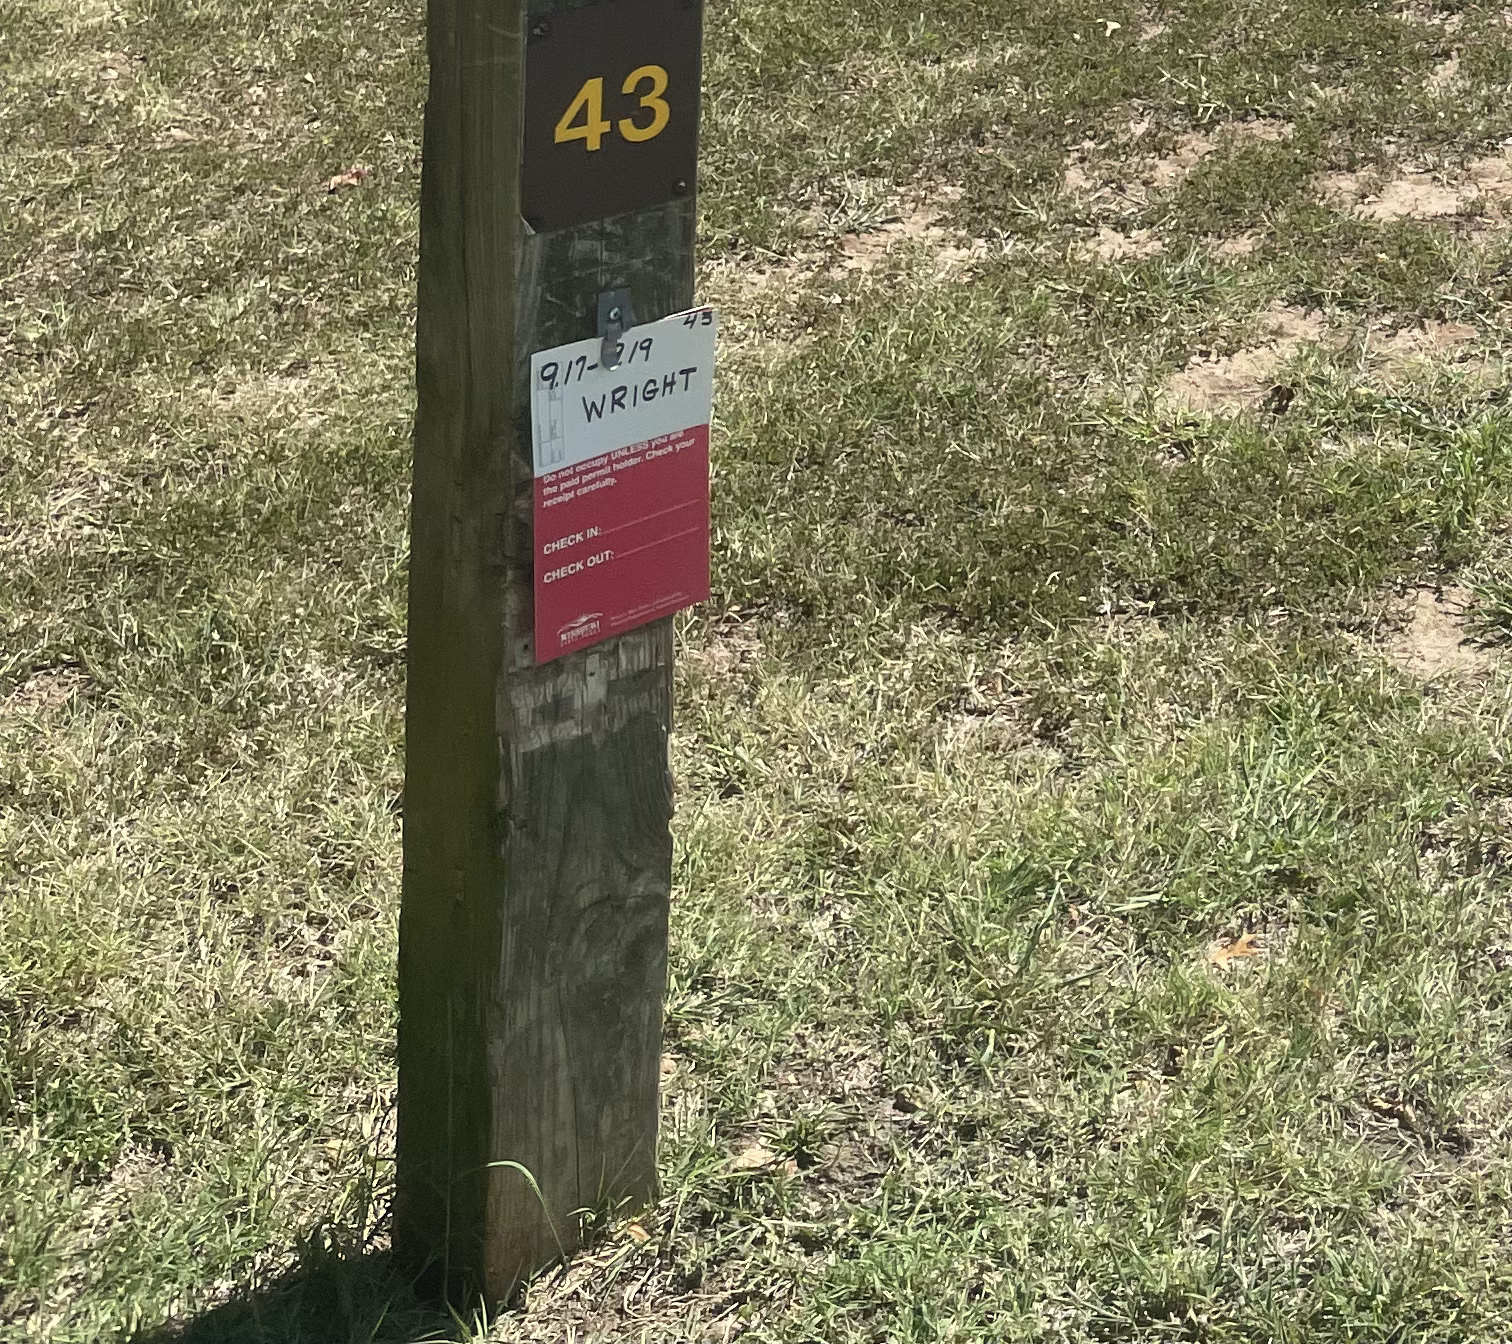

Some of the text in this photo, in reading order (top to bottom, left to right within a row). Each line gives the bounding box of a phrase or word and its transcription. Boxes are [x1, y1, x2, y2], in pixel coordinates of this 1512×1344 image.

[554, 64, 671, 152] 43
[581, 366, 698, 423] WRIGHT
[542, 484, 558, 496] the
[559, 475, 580, 492] paid
[581, 465, 611, 485] permit
[645, 444, 674, 461] Check
[675, 437, 696, 453] your
[558, 465, 574, 479] not
[575, 455, 609, 473] occupy
[610, 440, 649, 460] UNLESS
[650, 435, 668, 449] you
[542, 476, 618, 509] receipt carefully.
[543, 525, 603, 555] CHECK IN:
[543, 549, 615, 584] CHECK OUT:
